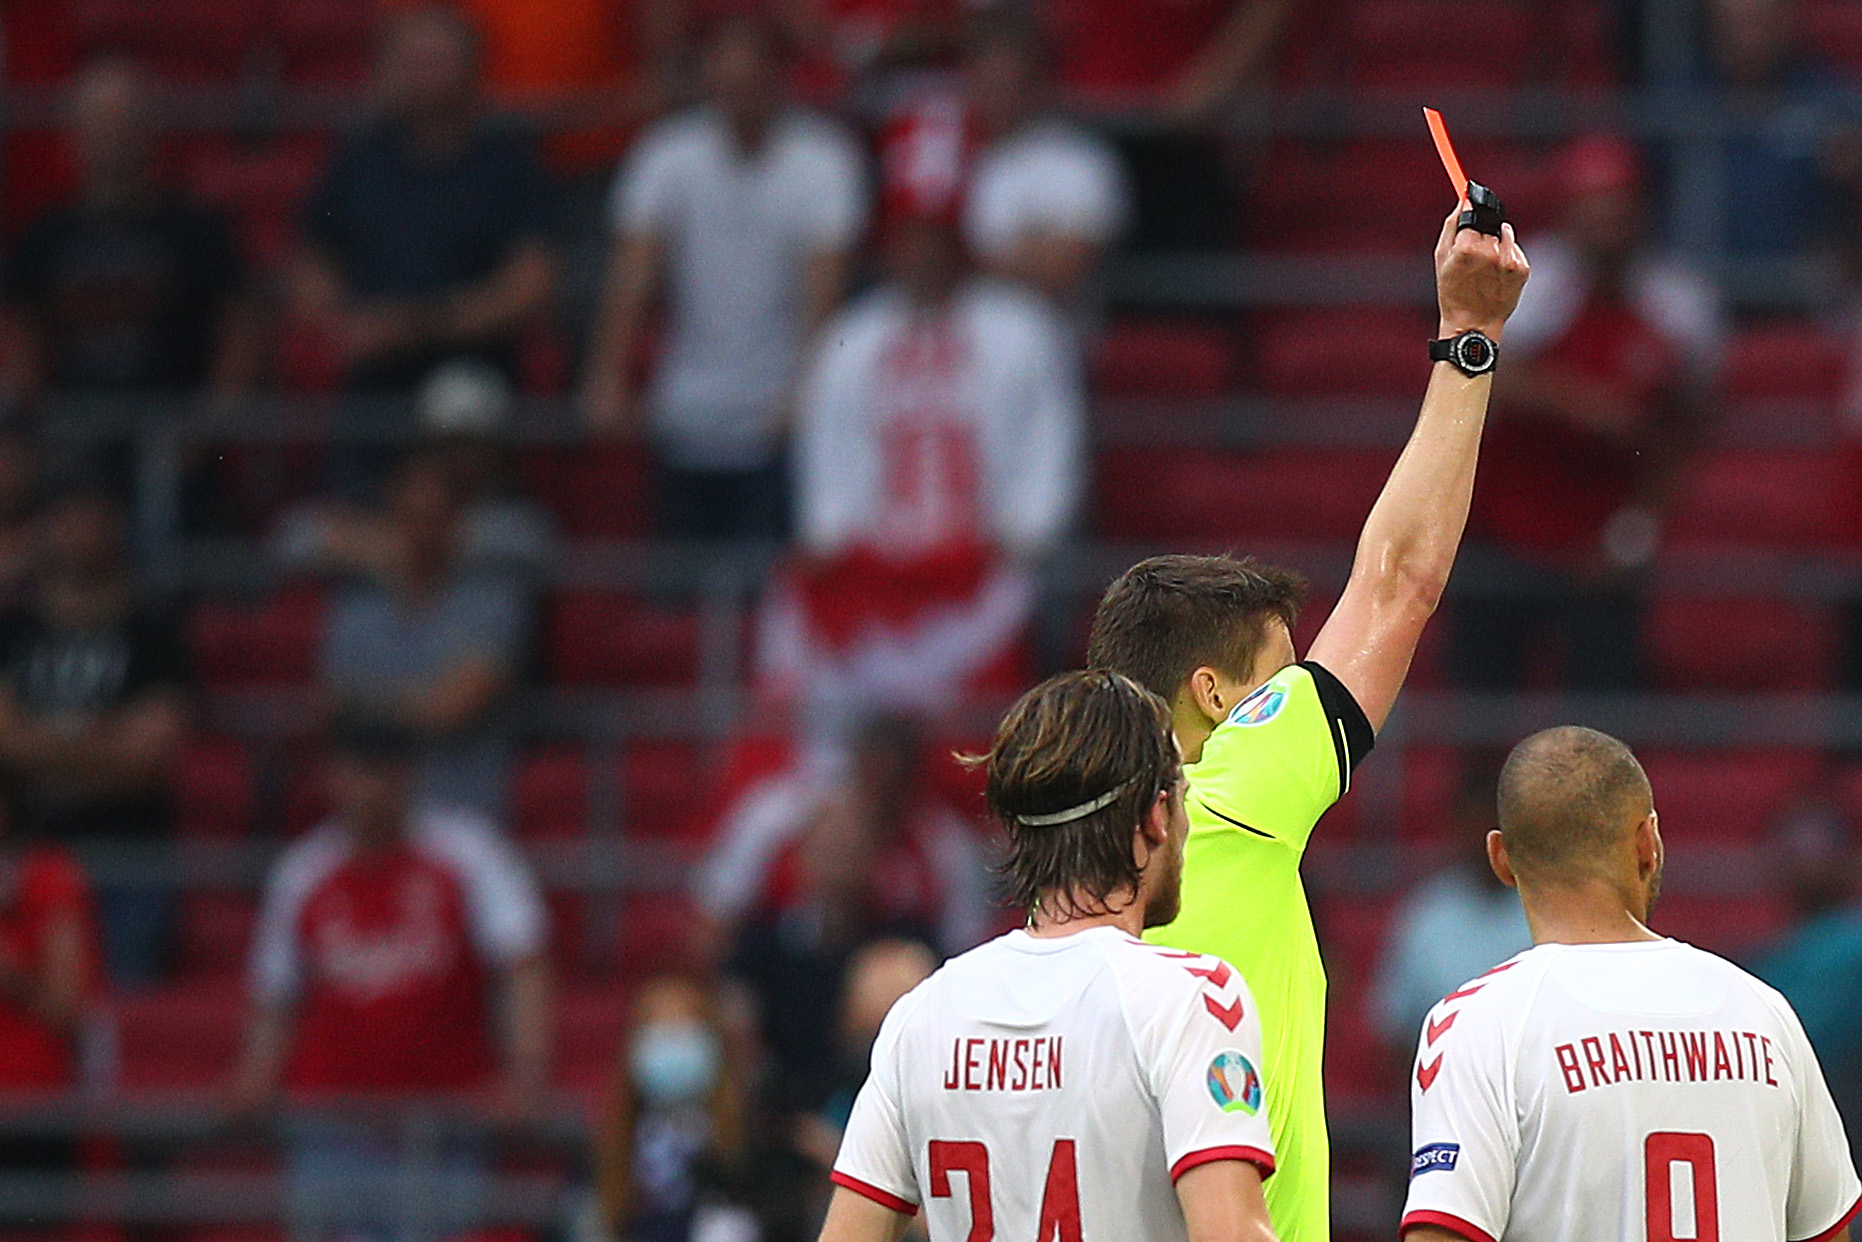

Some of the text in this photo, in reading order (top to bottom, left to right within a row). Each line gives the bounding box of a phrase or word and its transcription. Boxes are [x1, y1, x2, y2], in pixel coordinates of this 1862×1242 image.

[944, 1036, 1062, 1091] JENSEN
[1555, 1030, 1778, 1095] BRAITHWAITE
[1413, 1150, 1457, 1168] ESPECT
